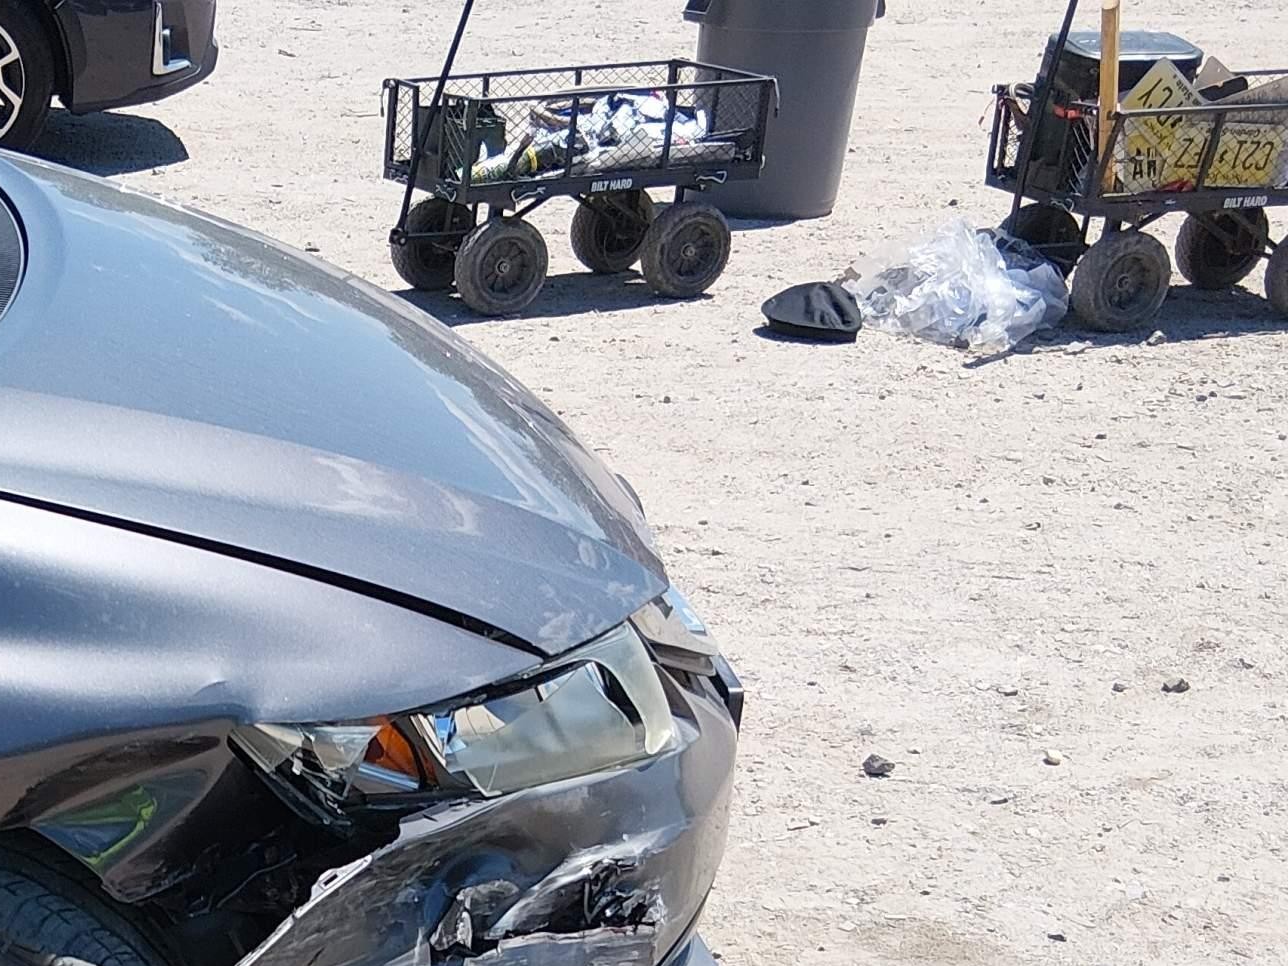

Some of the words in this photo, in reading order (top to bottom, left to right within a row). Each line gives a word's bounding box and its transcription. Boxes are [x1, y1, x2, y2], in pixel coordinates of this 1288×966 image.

[609, 178, 633, 191] HARD
[1223, 196, 1244, 209] BILT
[1243, 195, 1268, 208] HARD
